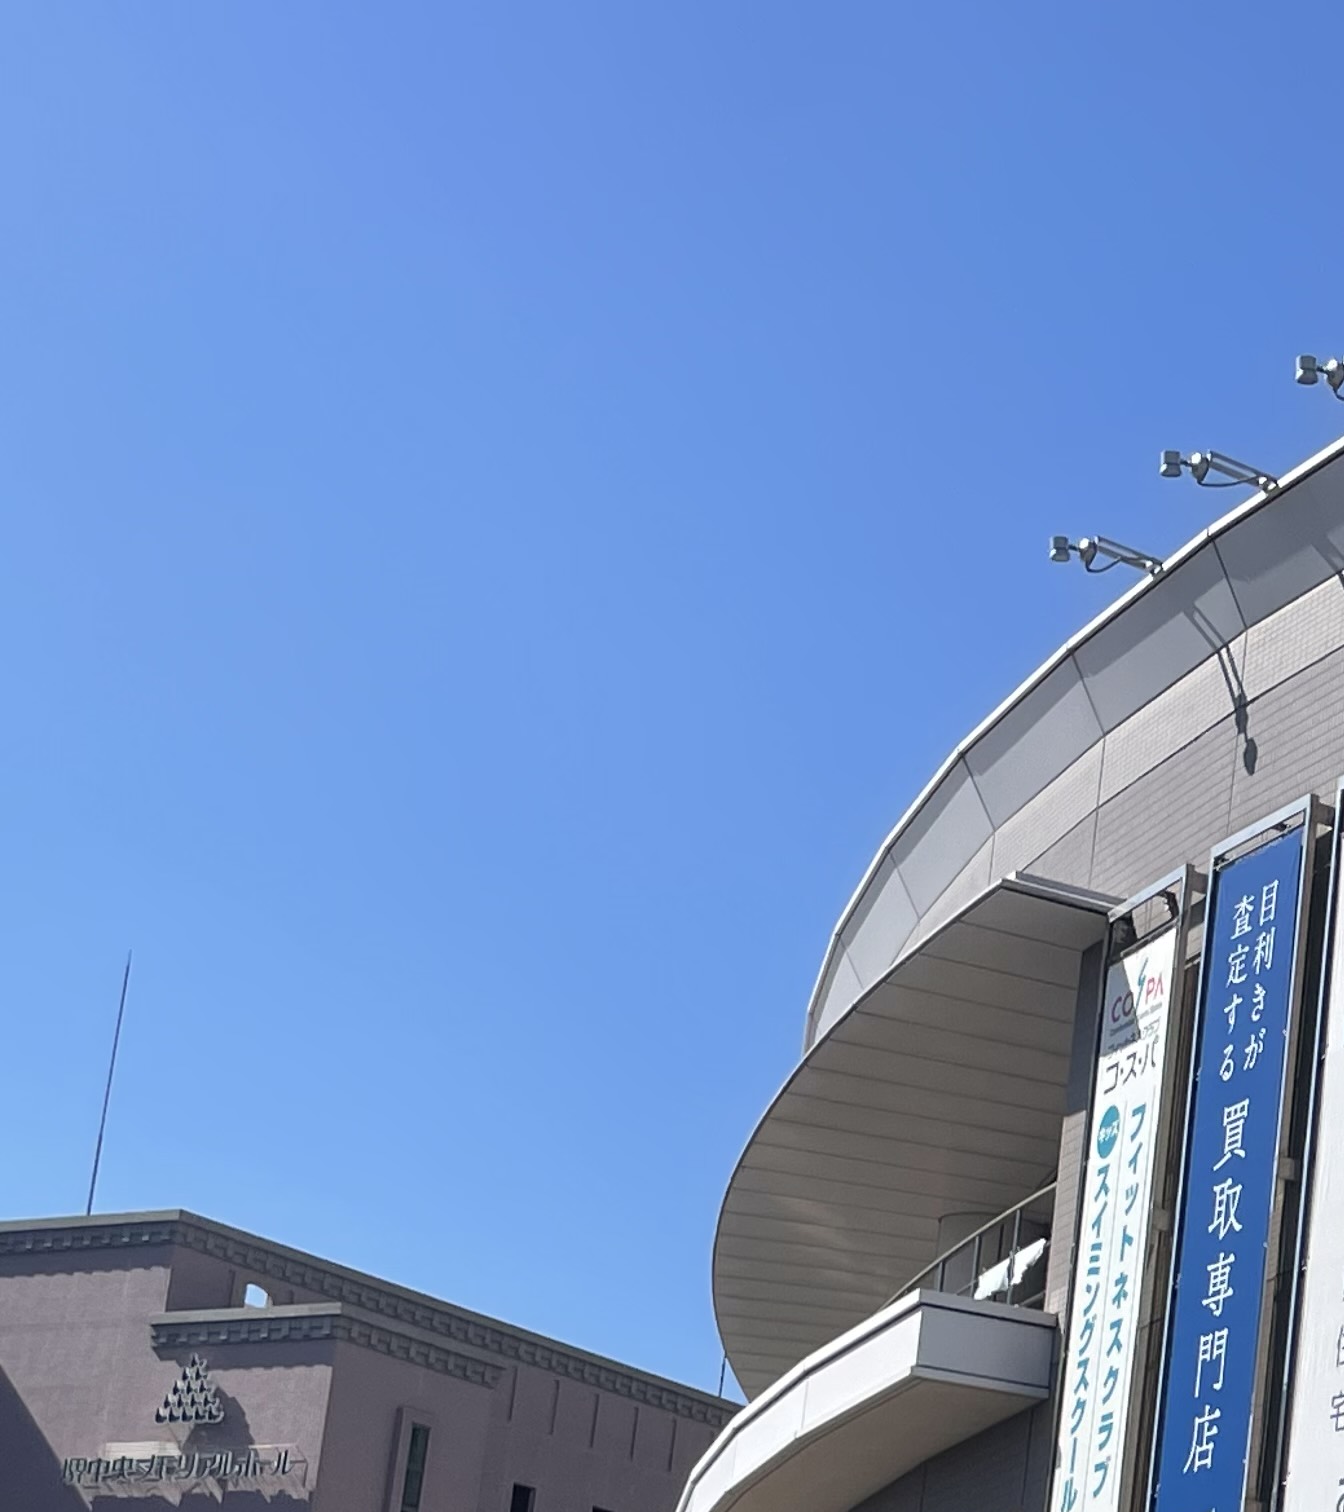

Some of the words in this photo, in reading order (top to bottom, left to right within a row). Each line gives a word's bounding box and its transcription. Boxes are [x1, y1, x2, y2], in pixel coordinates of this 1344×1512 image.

[1218, 894, 1256, 1083] 査定する
[1244, 879, 1280, 1071] 目利きが
[1092, 1102, 1148, 1500] フィットネスクラブ
[1182, 1097, 1251, 1476] 買取専門店
